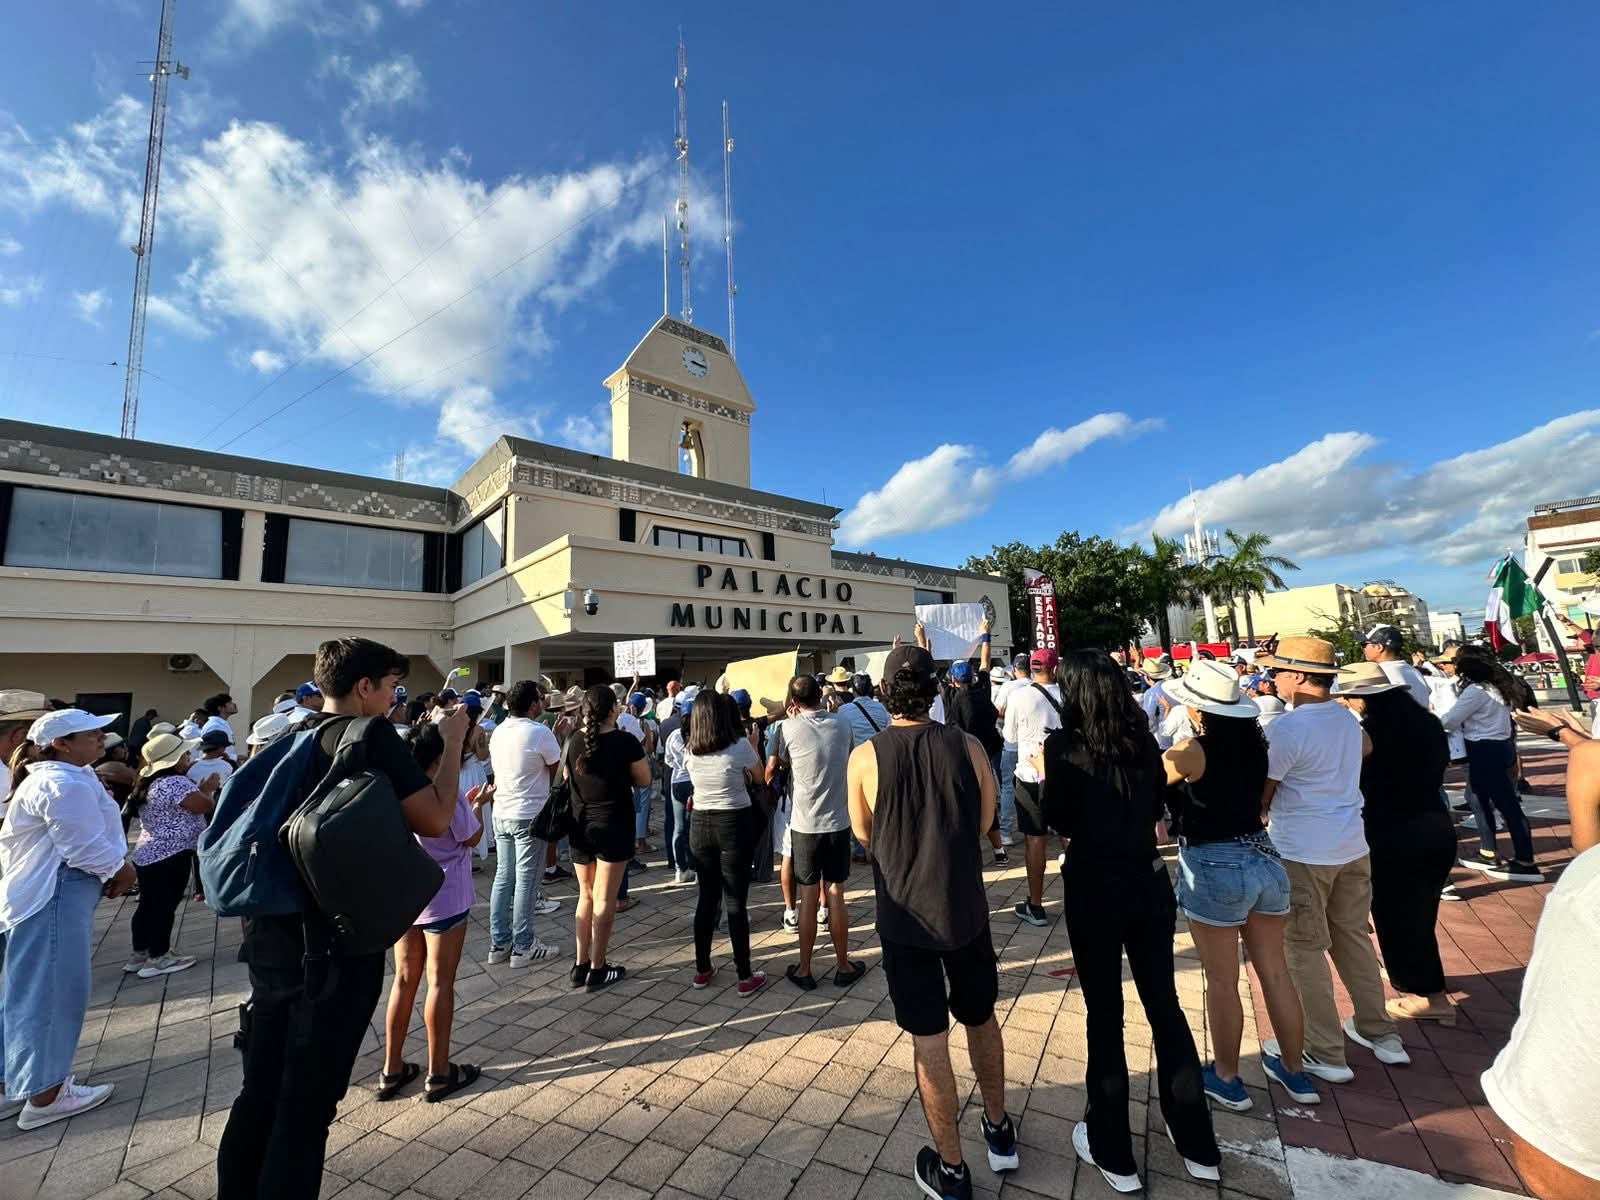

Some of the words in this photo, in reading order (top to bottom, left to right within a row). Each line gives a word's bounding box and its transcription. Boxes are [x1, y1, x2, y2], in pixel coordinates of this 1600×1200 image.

[697, 564, 852, 602] PALACIO
[670, 603, 863, 635] MUNICIPAL
[1034, 596, 1045, 649] ESTADO
[1045, 596, 1056, 649] FALLIDO
